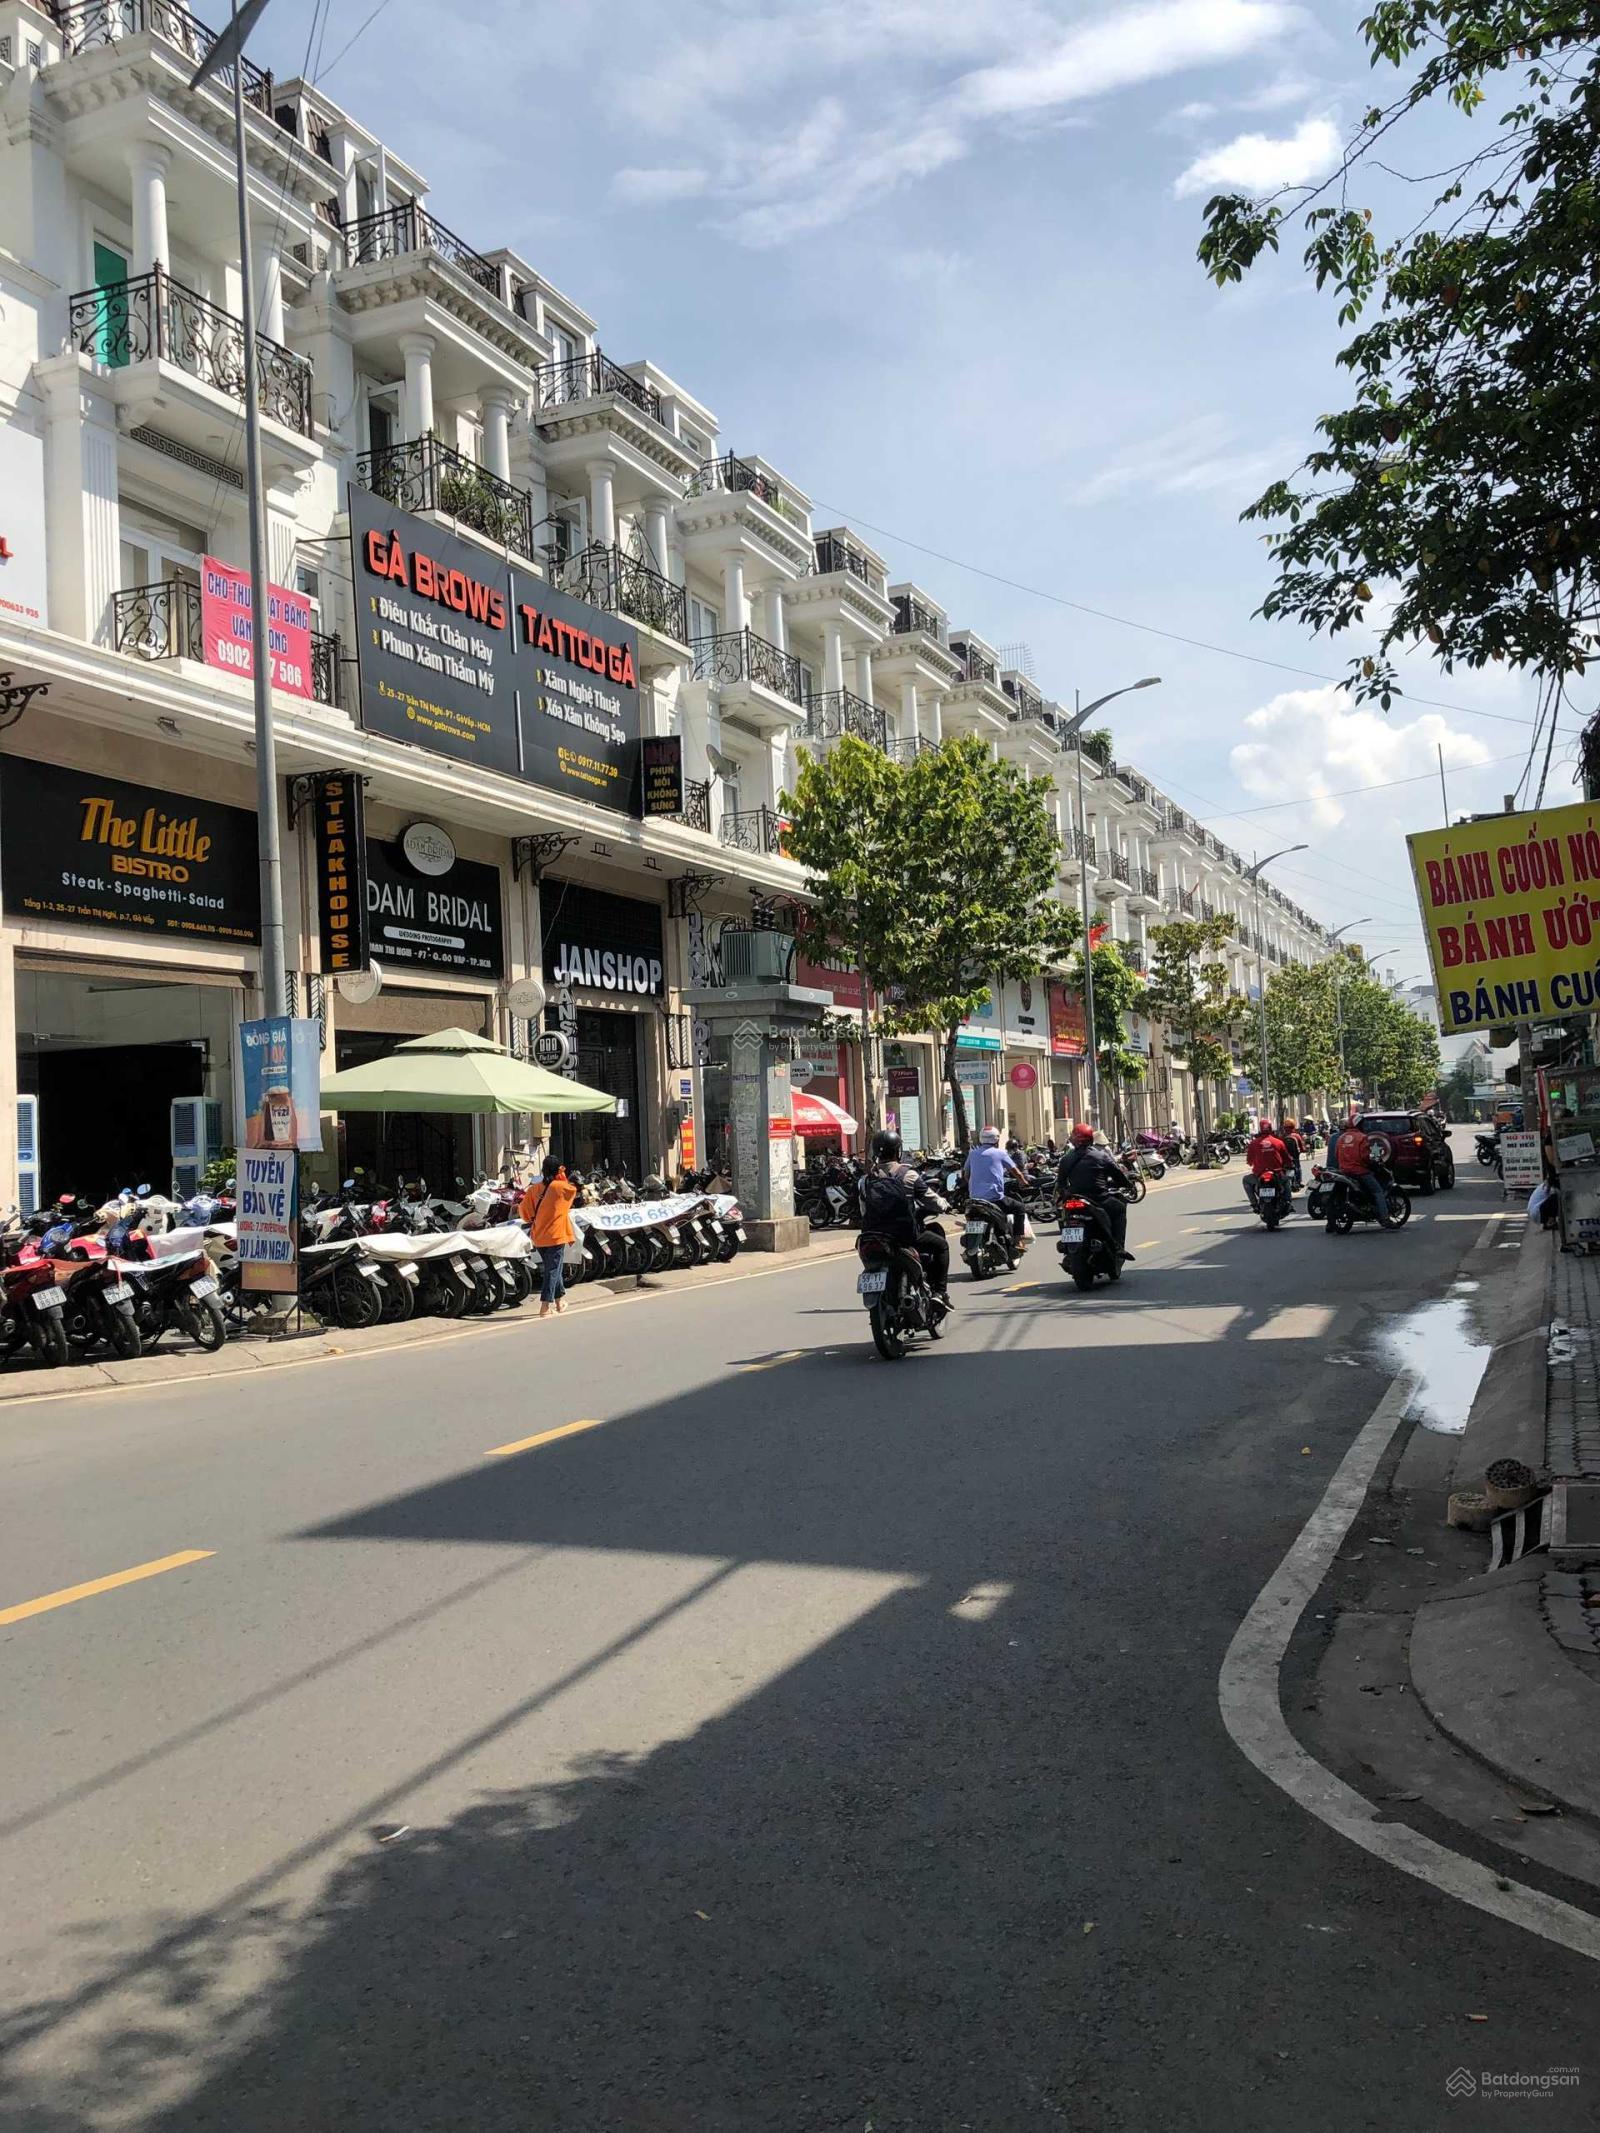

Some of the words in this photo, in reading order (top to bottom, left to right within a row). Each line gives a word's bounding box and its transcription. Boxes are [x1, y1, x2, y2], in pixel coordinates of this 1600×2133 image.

[207, 572, 229, 599] CHO
[232, 582, 252, 608] THU
[368, 529, 409, 586] GÀ
[413, 552, 506, 630] BROWS
[217, 639, 251, 670] 0902
[409, 609, 440, 641] Khắc
[440, 624, 469, 655] Chân
[470, 636, 494, 666] Mày
[522, 603, 606, 675] TATTOO
[608, 642, 637, 690] GÀ
[381, 629, 415, 664] Phun
[416, 642, 444, 674] Xăm
[477, 668, 496, 696] Mỹ
[544, 668, 568, 696] Xăm
[568, 679, 594, 708] Nghệ
[593, 689, 622, 718] Thuật
[545, 696, 563, 720] Xóa
[563, 703, 584, 729] Xăm
[583, 711, 611, 743] Không
[610, 724, 626, 746] Sẹo
[646, 787, 680, 800] KHÔNG
[649, 765, 676, 777] PHUN
[79, 796, 138, 850] The
[140, 807, 212, 864] Little
[111, 853, 190, 884] BISTRO
[323, 780, 350, 968] STEAKHOUSE
[1425, 844, 1495, 908] BÁNH
[1497, 821, 1565, 894] CUỐN
[61, 871, 105, 892] Steak
[114, 880, 182, 904] Spaghetti
[188, 892, 225, 911] Salad
[366, 878, 415, 920] DAM
[427, 890, 493, 933] BRIDAL
[1437, 911, 1536, 968] BÁNH
[1543, 892, 1600, 950] ƯỚ
[554, 943, 662, 994] JANSHOP
[1450, 978, 1541, 1025] BÁNH
[271, 1027, 287, 1043] GIÁ
[245, 1152, 285, 1184] TUYỂN
[243, 1184, 266, 1215] BẢO
[268, 1188, 285, 1221] VỆ
[601, 1212, 643, 1227] 0286
[250, 1235, 268, 1259] LÀM
[268, 1240, 290, 1260] NGAY
